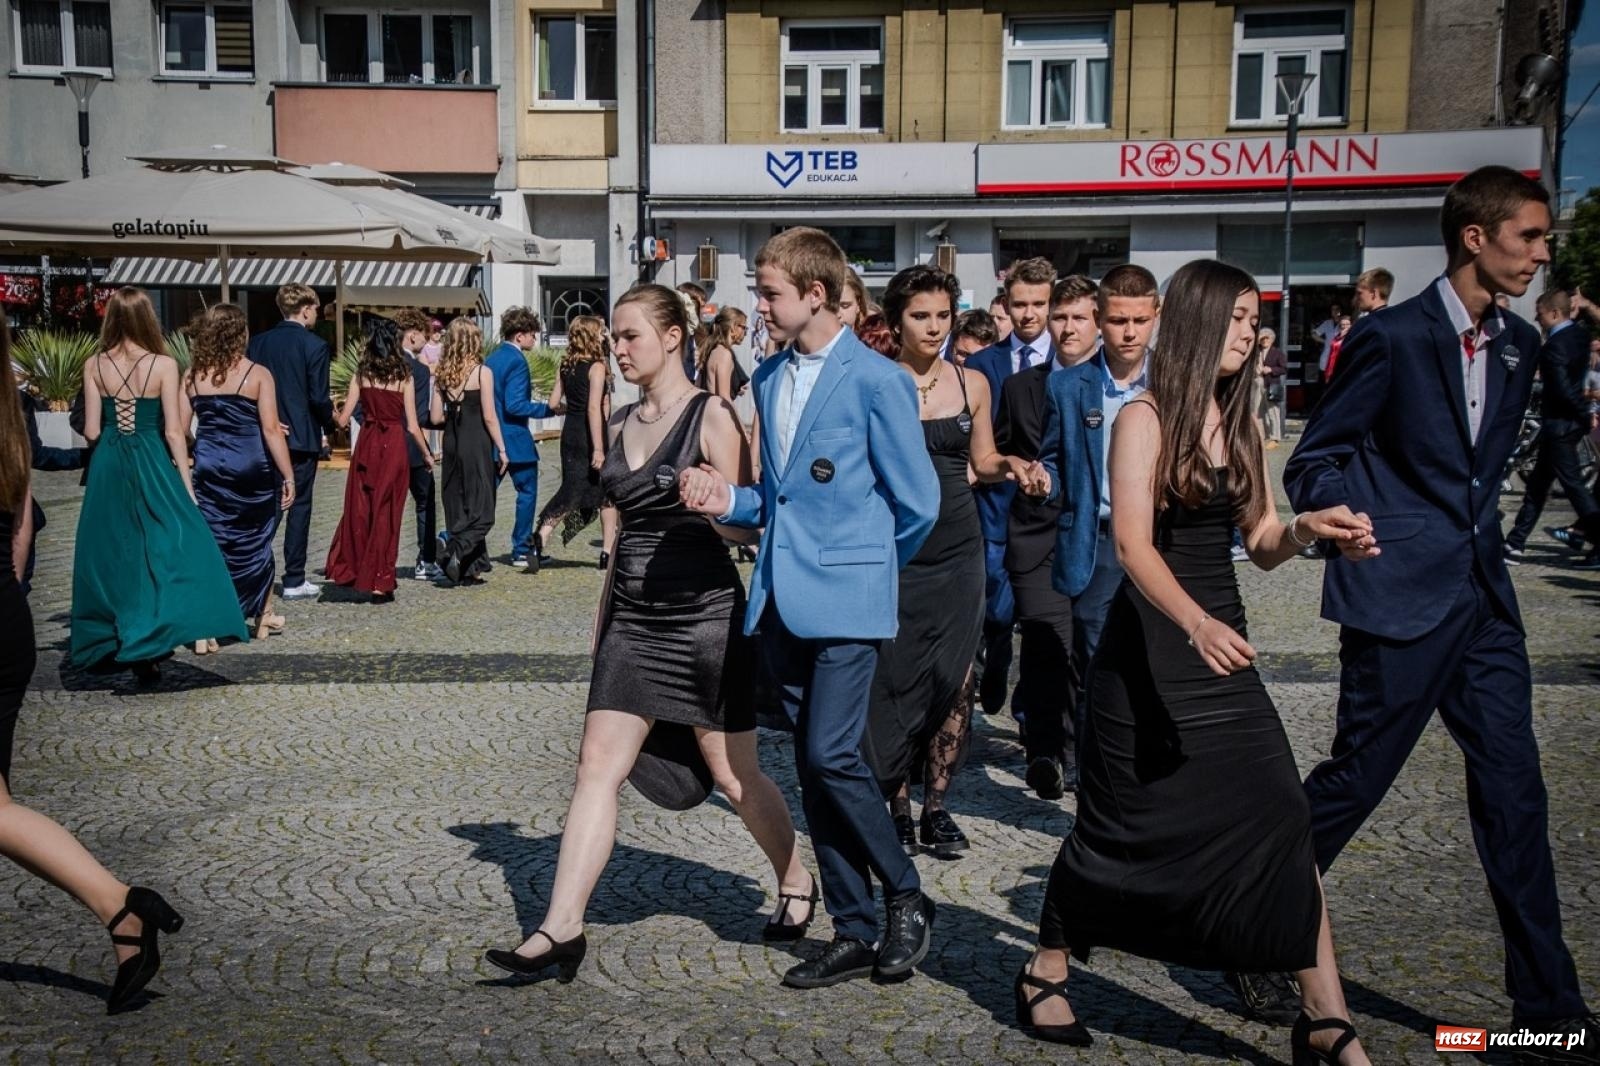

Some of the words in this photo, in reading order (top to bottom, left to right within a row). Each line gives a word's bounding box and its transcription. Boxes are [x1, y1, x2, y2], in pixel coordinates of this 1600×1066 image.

[807, 150, 858, 170] TEB
[1120, 137, 1378, 178] ROSSMANN
[806, 174, 858, 182] EDUKACJA
[112, 217, 209, 240] gelatopiu
